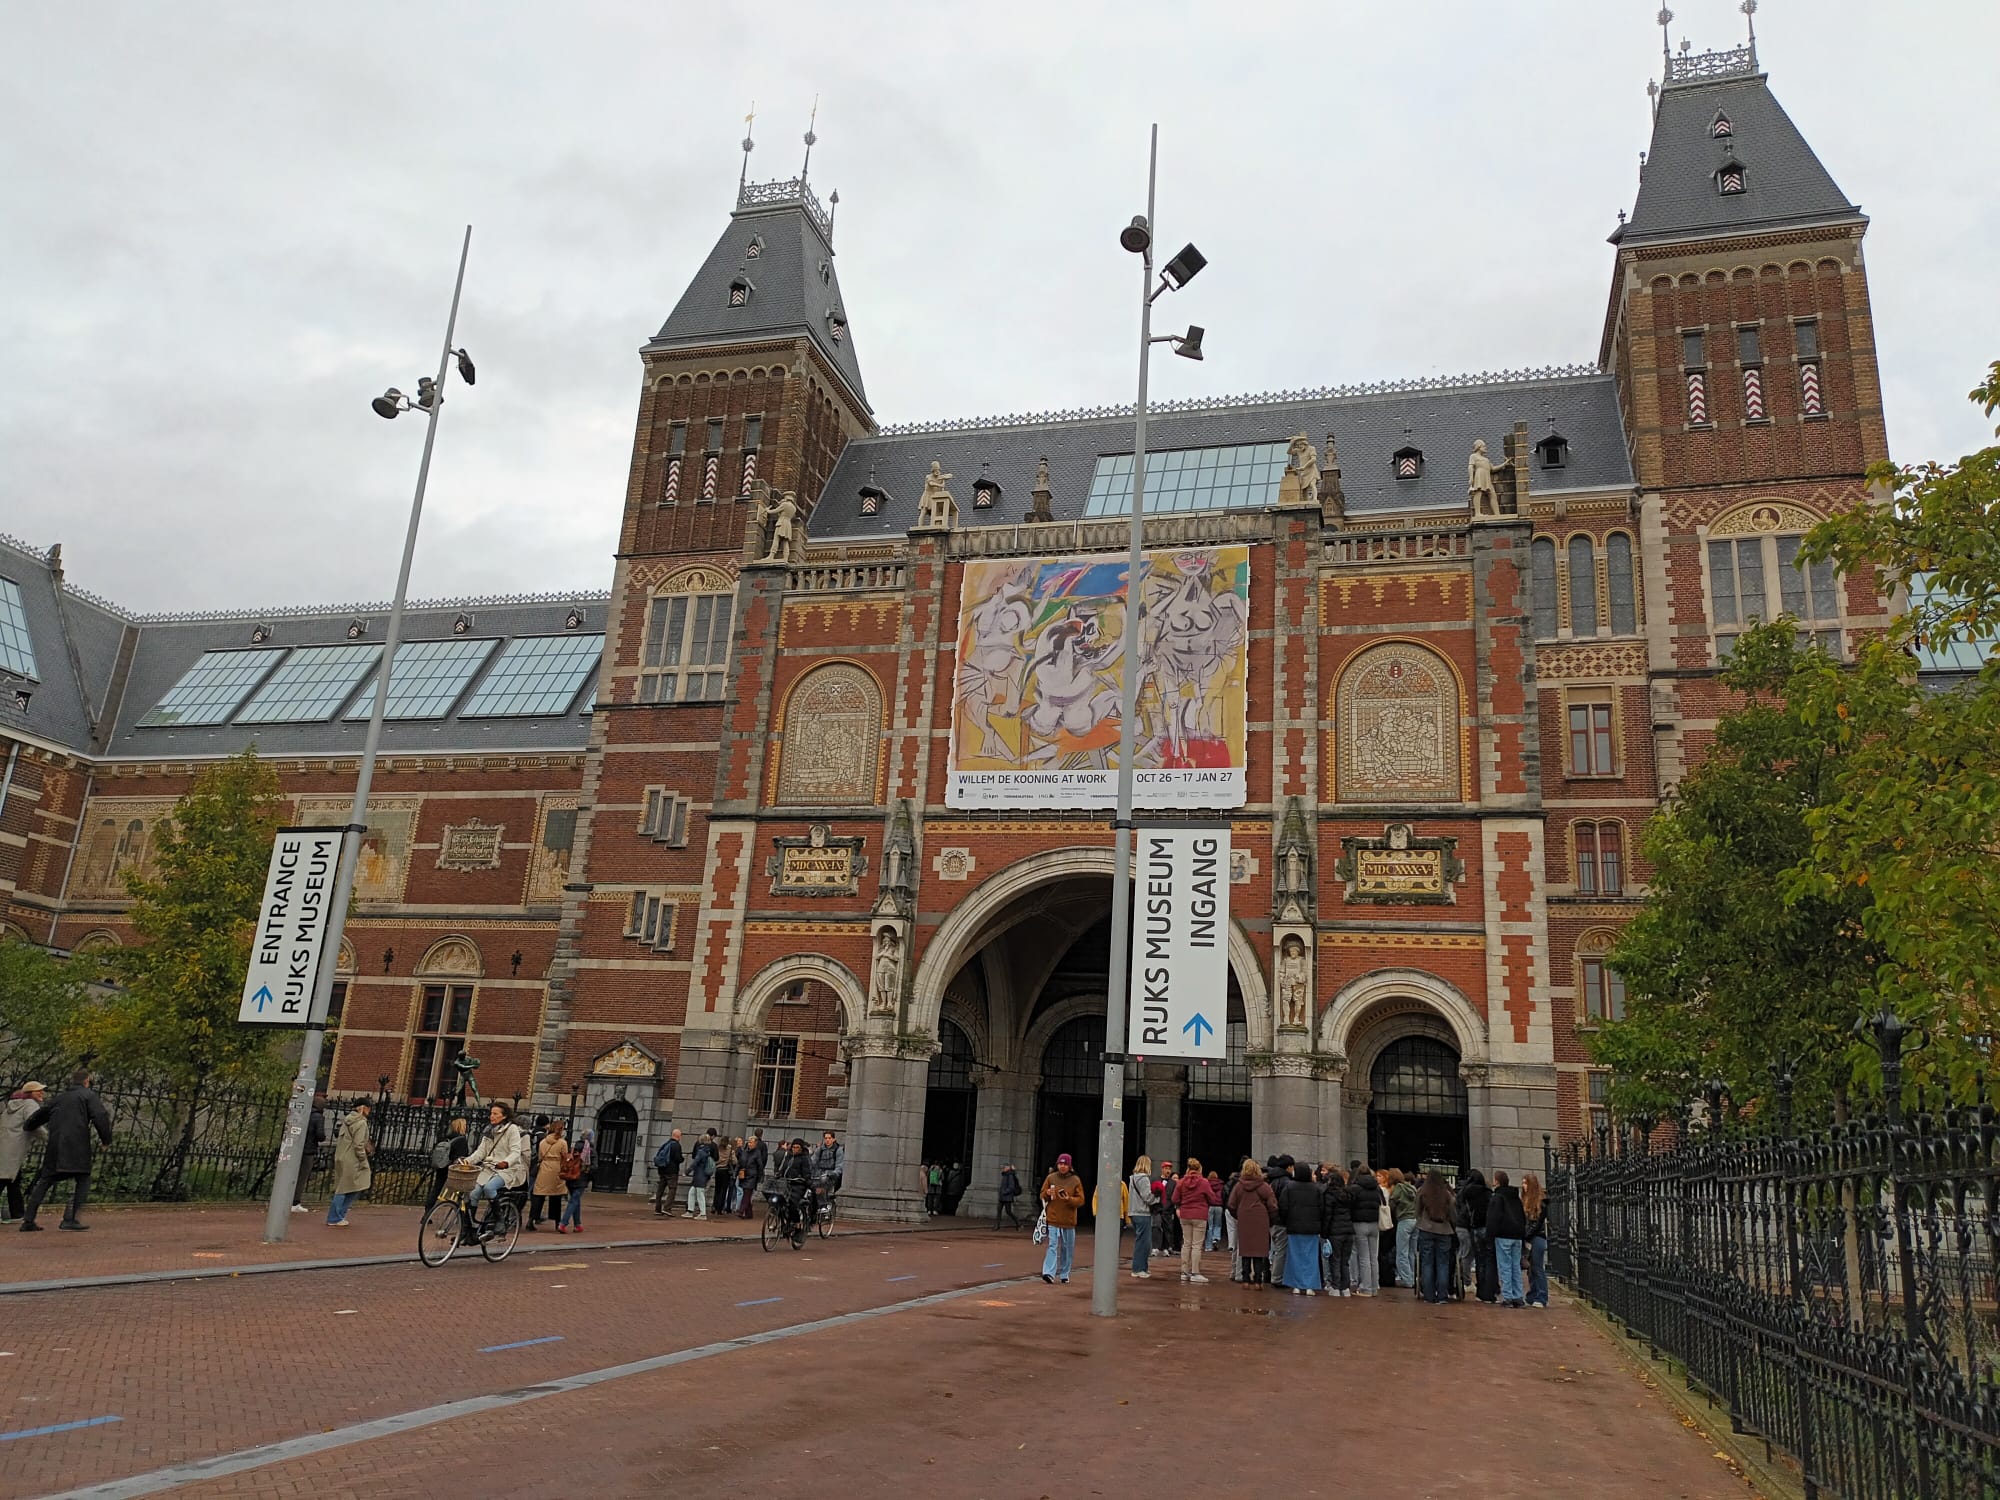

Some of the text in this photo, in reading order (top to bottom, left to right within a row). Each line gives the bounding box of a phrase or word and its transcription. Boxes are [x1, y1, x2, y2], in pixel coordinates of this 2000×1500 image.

[958, 774, 1107, 784] WILLEM DE KOONING AT WORK
[1136, 773, 1156, 783] OCT
[1159, 773, 1172, 783] 26
[1183, 773, 1193, 782] 17
[1196, 772, 1217, 782] JAN
[1220, 772, 1233, 782] 27
[259, 841, 301, 965] ENTRANCE
[281, 840, 332, 1014] RIJKS MUSEUM
[1142, 838, 1174, 1045] RIJKS MUSEUM
[1190, 838, 1218, 948] INGANG
